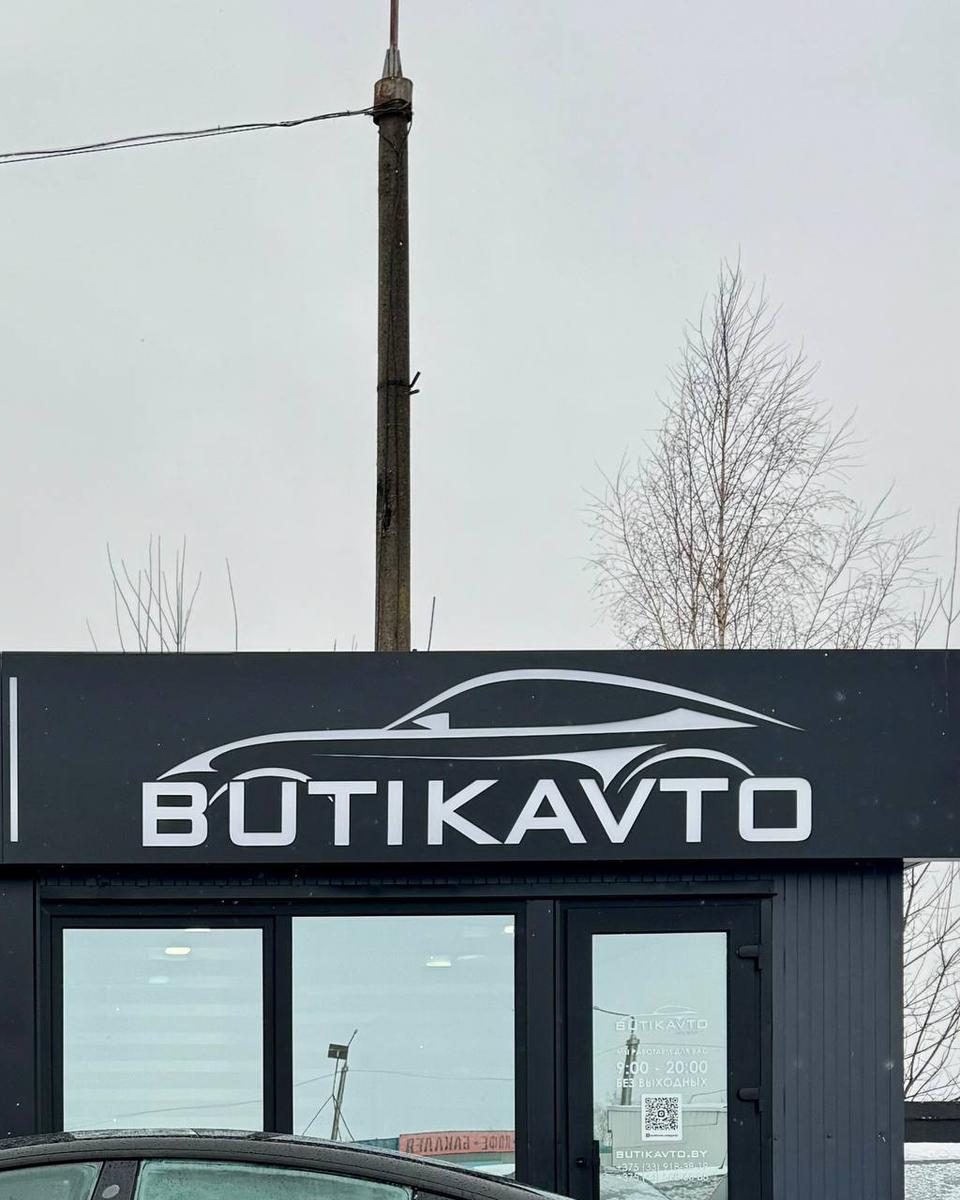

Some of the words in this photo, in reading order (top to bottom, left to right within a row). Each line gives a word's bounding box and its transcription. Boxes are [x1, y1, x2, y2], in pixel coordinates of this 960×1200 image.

[142, 777, 812, 848] BUTIKAVTO
[616, 1019, 708, 1031] BUTIKAVTO
[616, 1060, 648, 1074] 9:00
[666, 1060, 708, 1074] 20:00
[616, 1078, 635, 1088] БЕЗ
[638, 1077, 708, 1088] ВЫХОДНЫХ
[616, 1150, 708, 1159] BUTIKAVTO.BY
